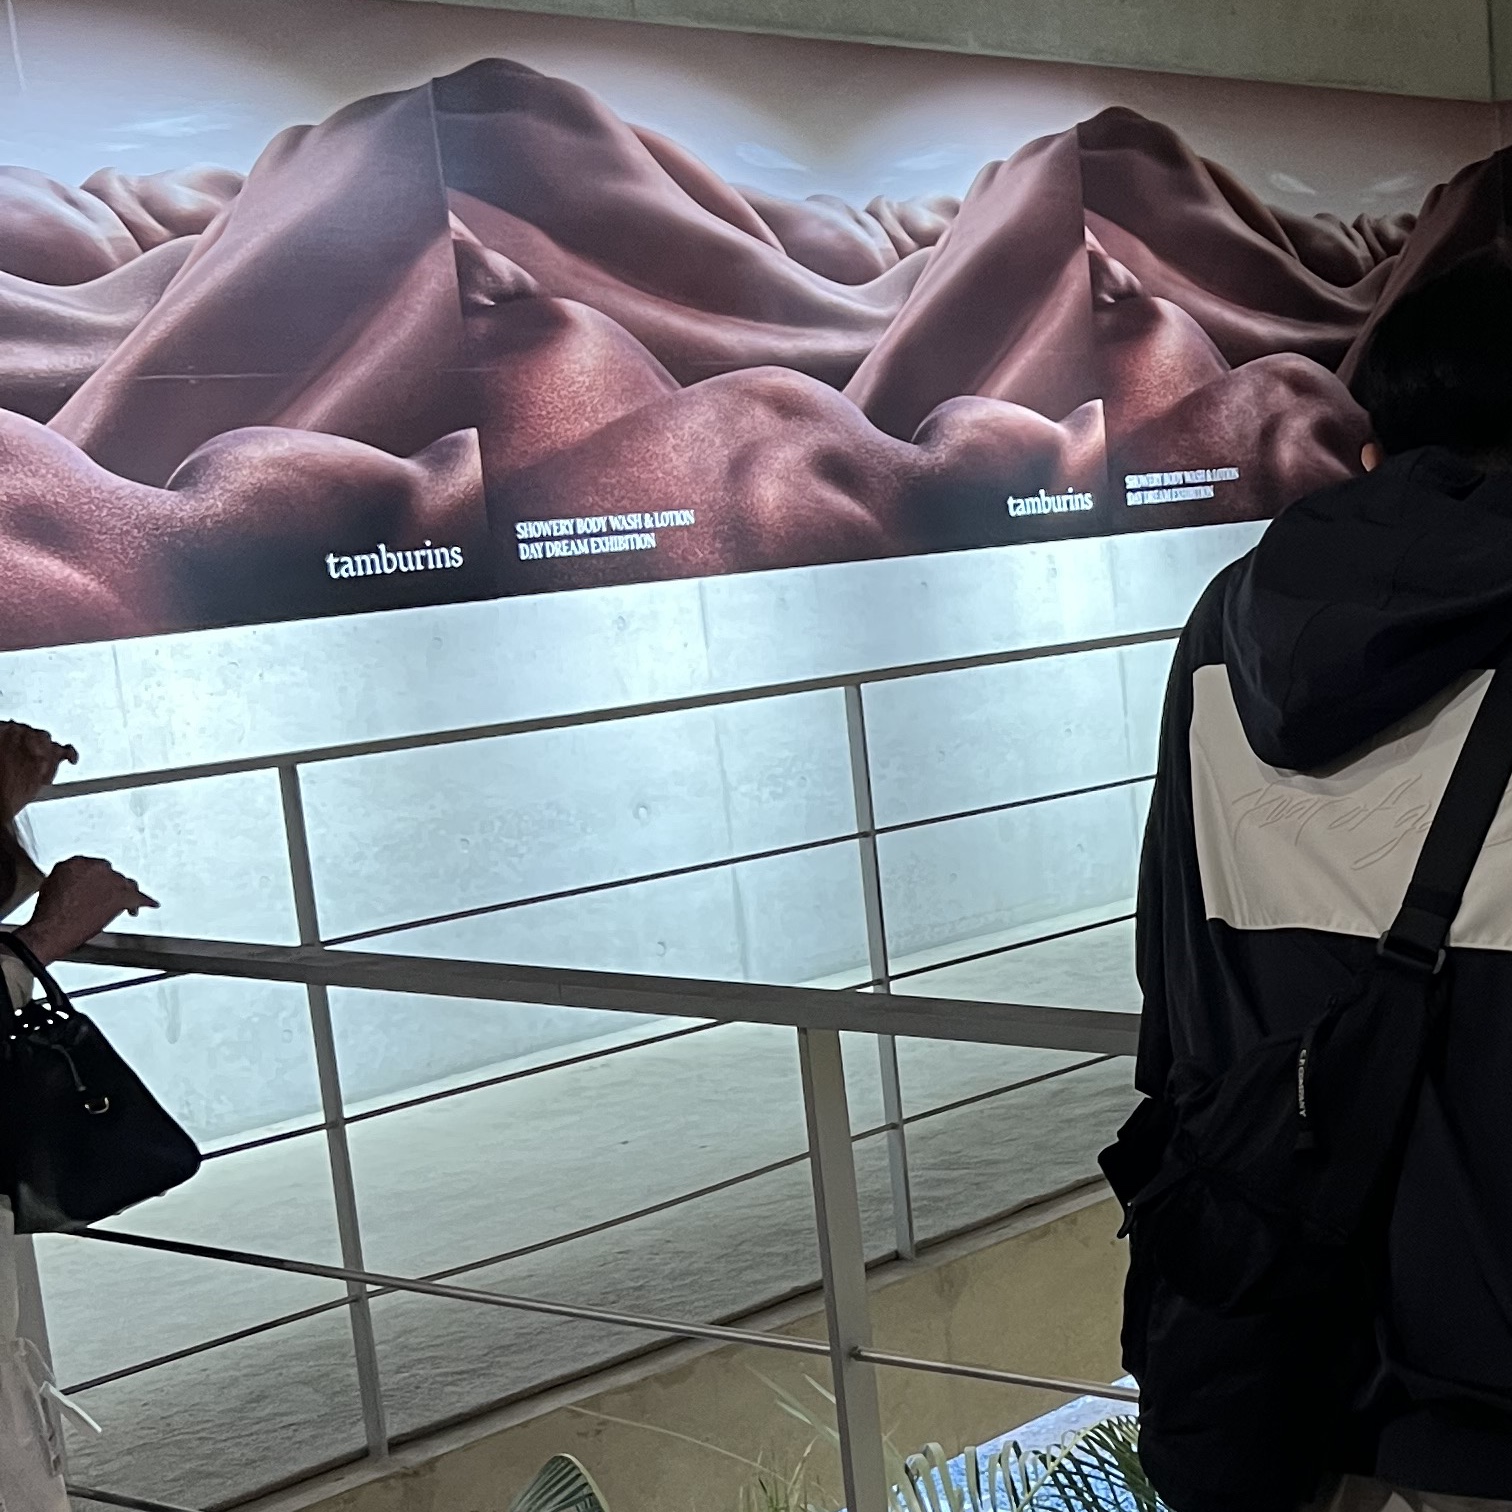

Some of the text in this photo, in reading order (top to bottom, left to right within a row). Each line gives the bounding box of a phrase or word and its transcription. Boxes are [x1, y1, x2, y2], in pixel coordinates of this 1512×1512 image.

[1006, 487, 1094, 517] tamburins
[515, 509, 696, 540] SHOWERY BODY WASH & LOTION
[325, 539, 464, 580] tamburins
[518, 532, 657, 561] DAY DREAM EXHIBITION
